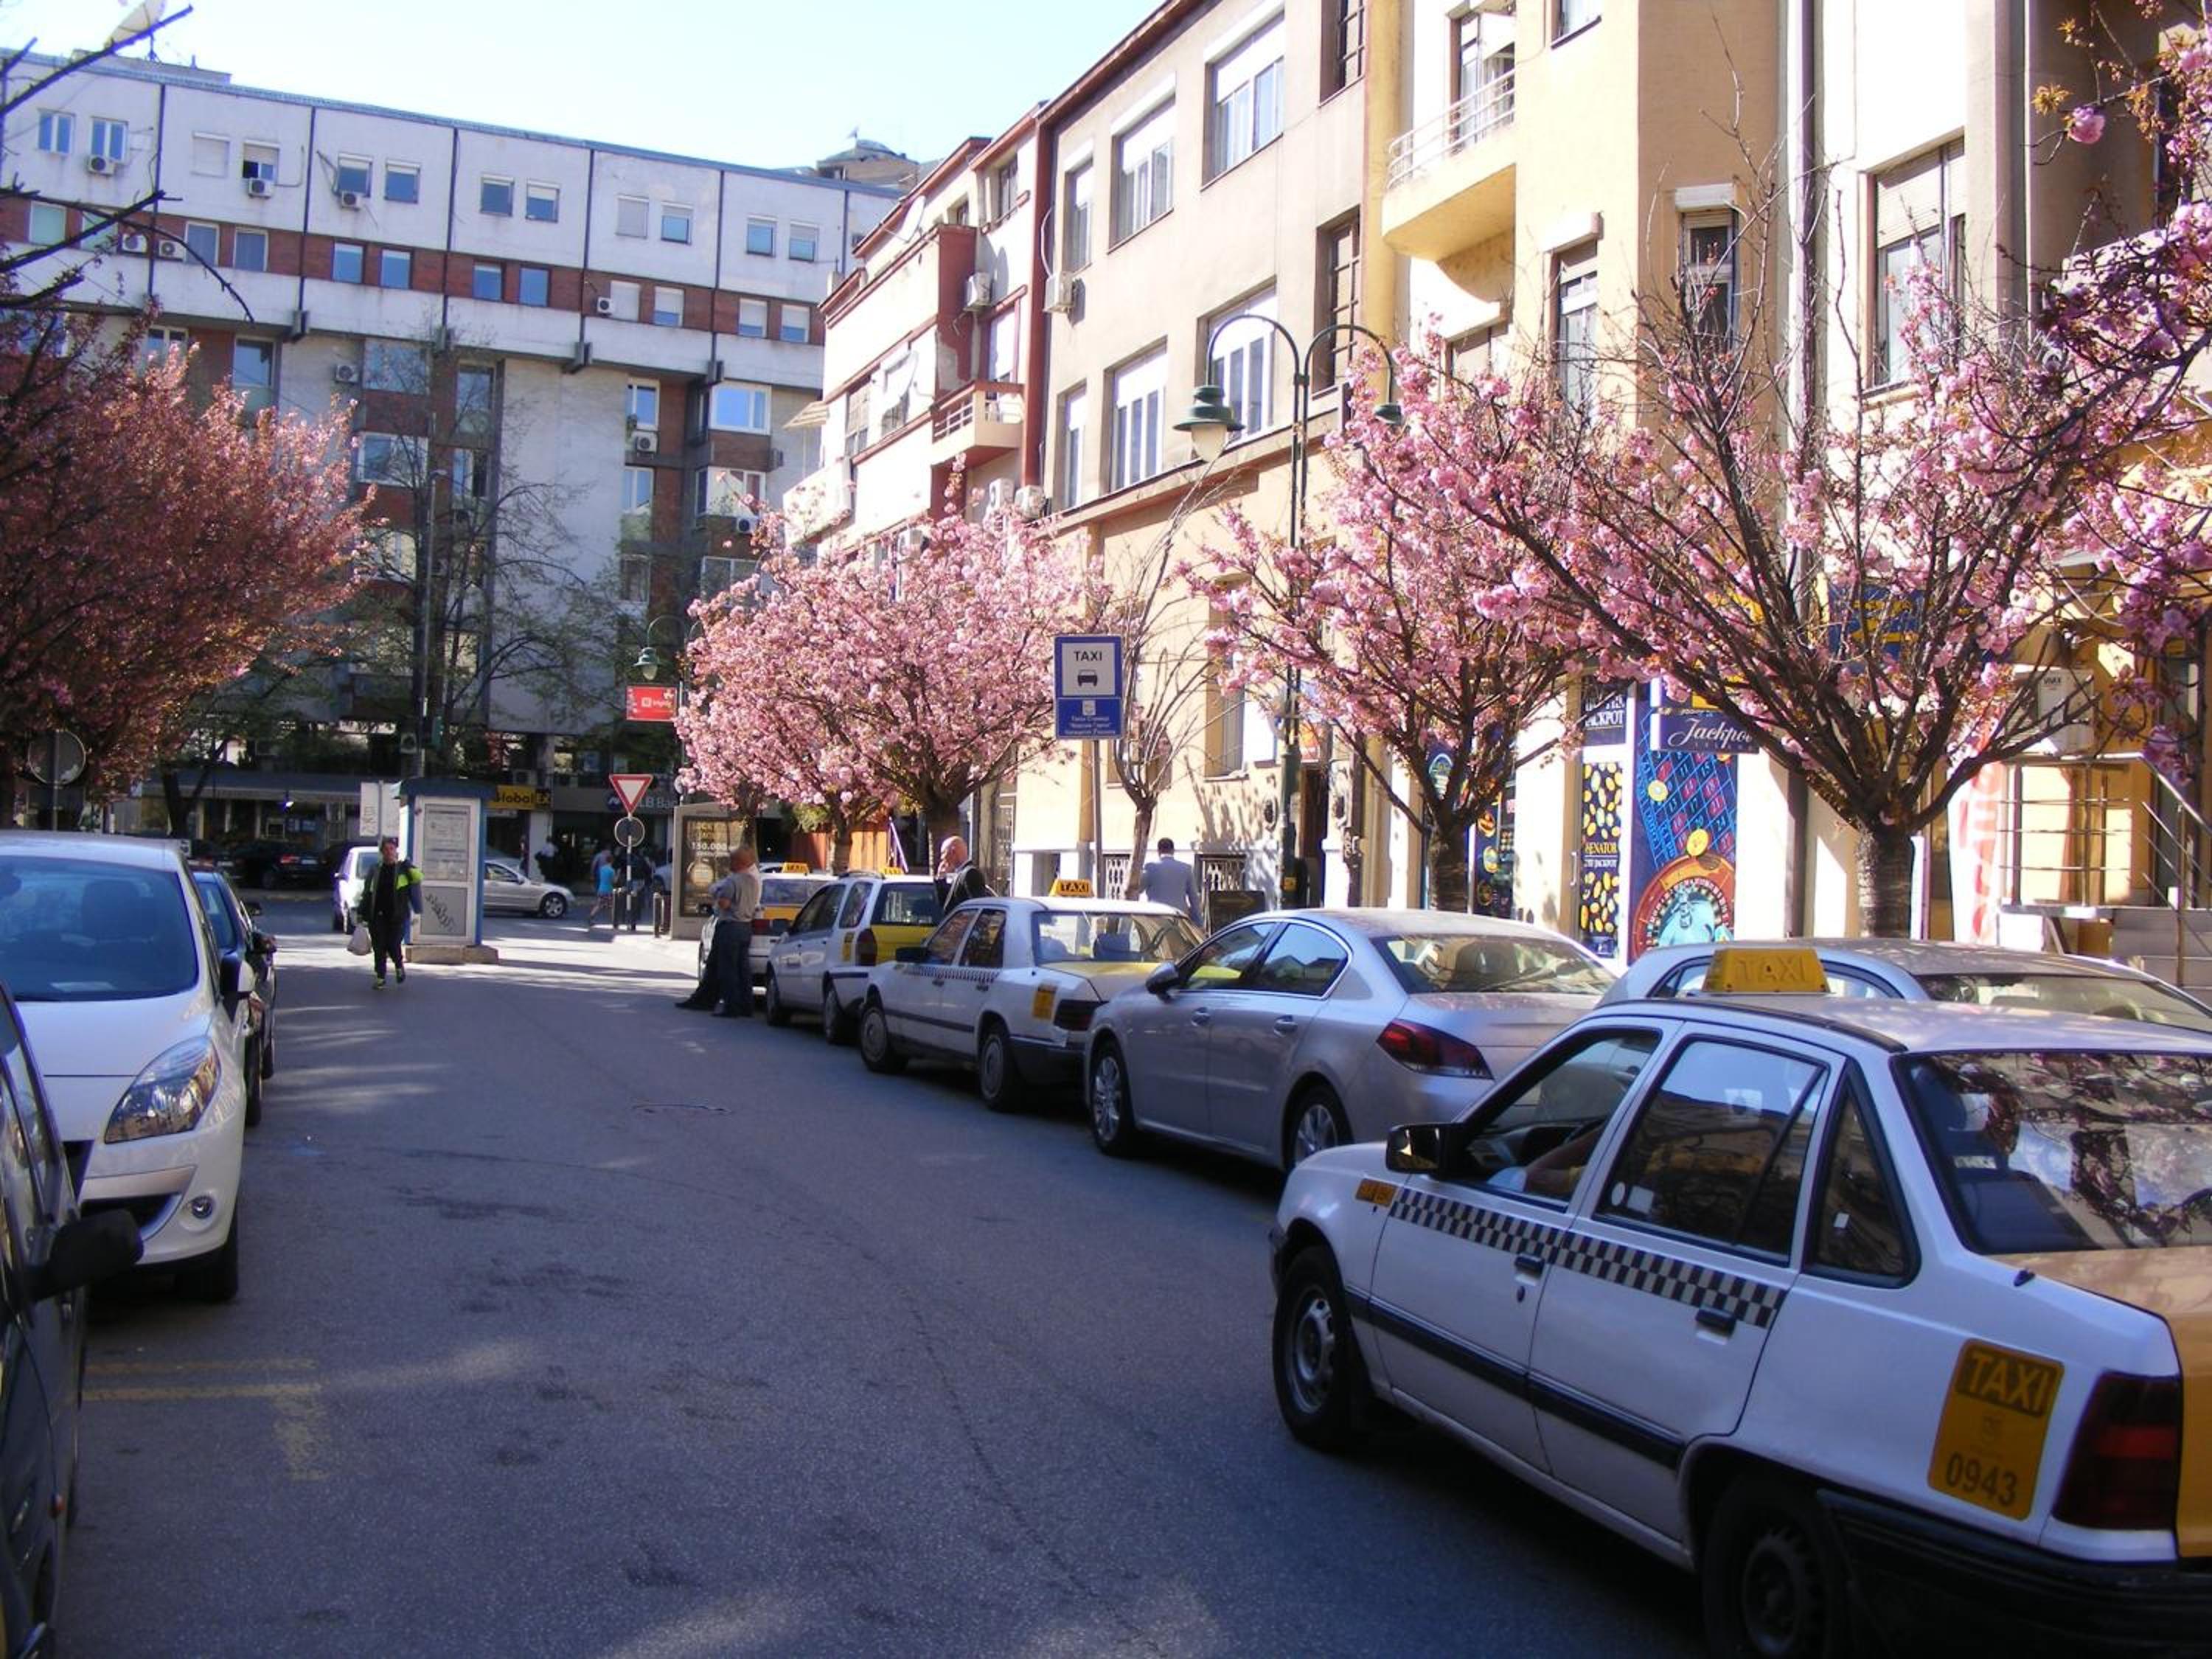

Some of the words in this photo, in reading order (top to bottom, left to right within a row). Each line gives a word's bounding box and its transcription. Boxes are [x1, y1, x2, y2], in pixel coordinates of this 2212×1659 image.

[1074, 650, 1102, 661] TAXI
[1062, 883, 1089, 892] TAXI
[1734, 956, 1806, 981] TAXI
[1969, 1352, 2051, 1413] TAXI
[1947, 1453, 2018, 1508] 0943
